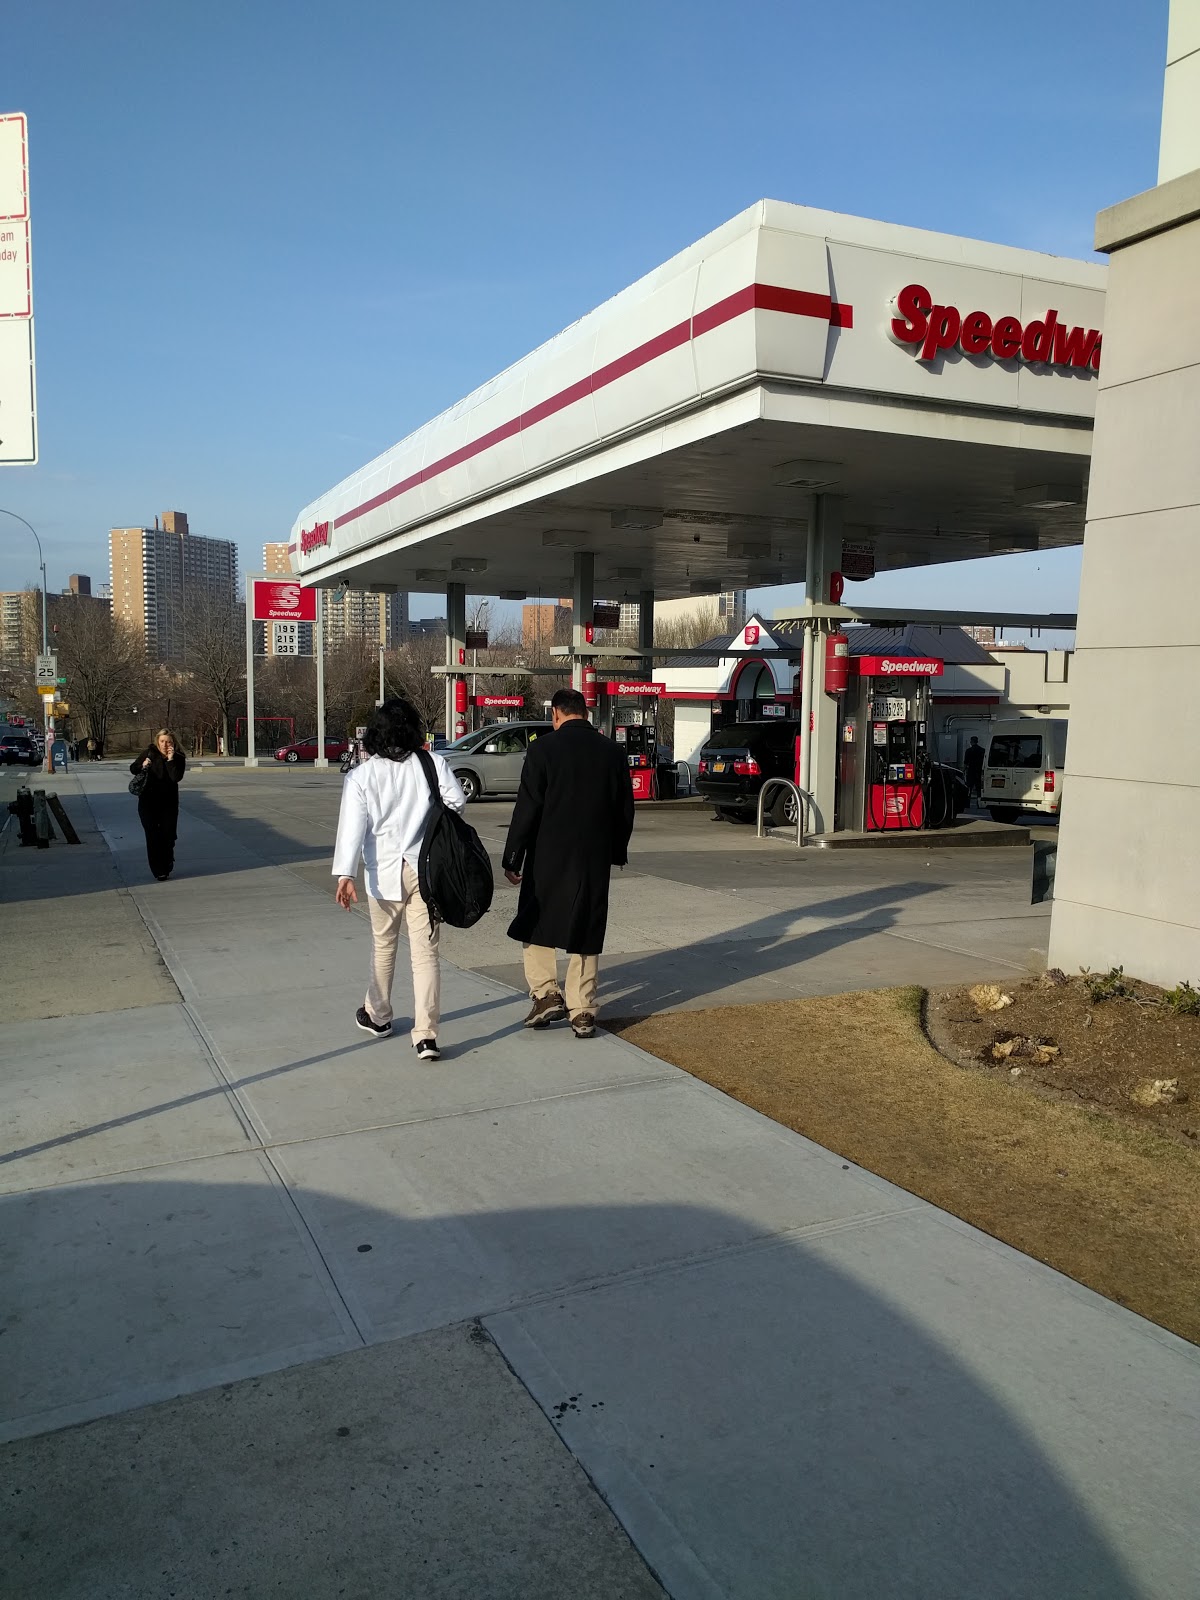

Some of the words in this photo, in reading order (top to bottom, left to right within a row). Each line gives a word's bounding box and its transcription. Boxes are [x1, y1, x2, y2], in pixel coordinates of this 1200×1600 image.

[0, 249, 17, 262] day
[268, 609, 302, 618] Speedway
[881, 660, 938, 674] Speedway
[38, 668, 54, 676] 25
[618, 684, 662, 694] Speedway
[483, 697, 521, 706] Speedway
